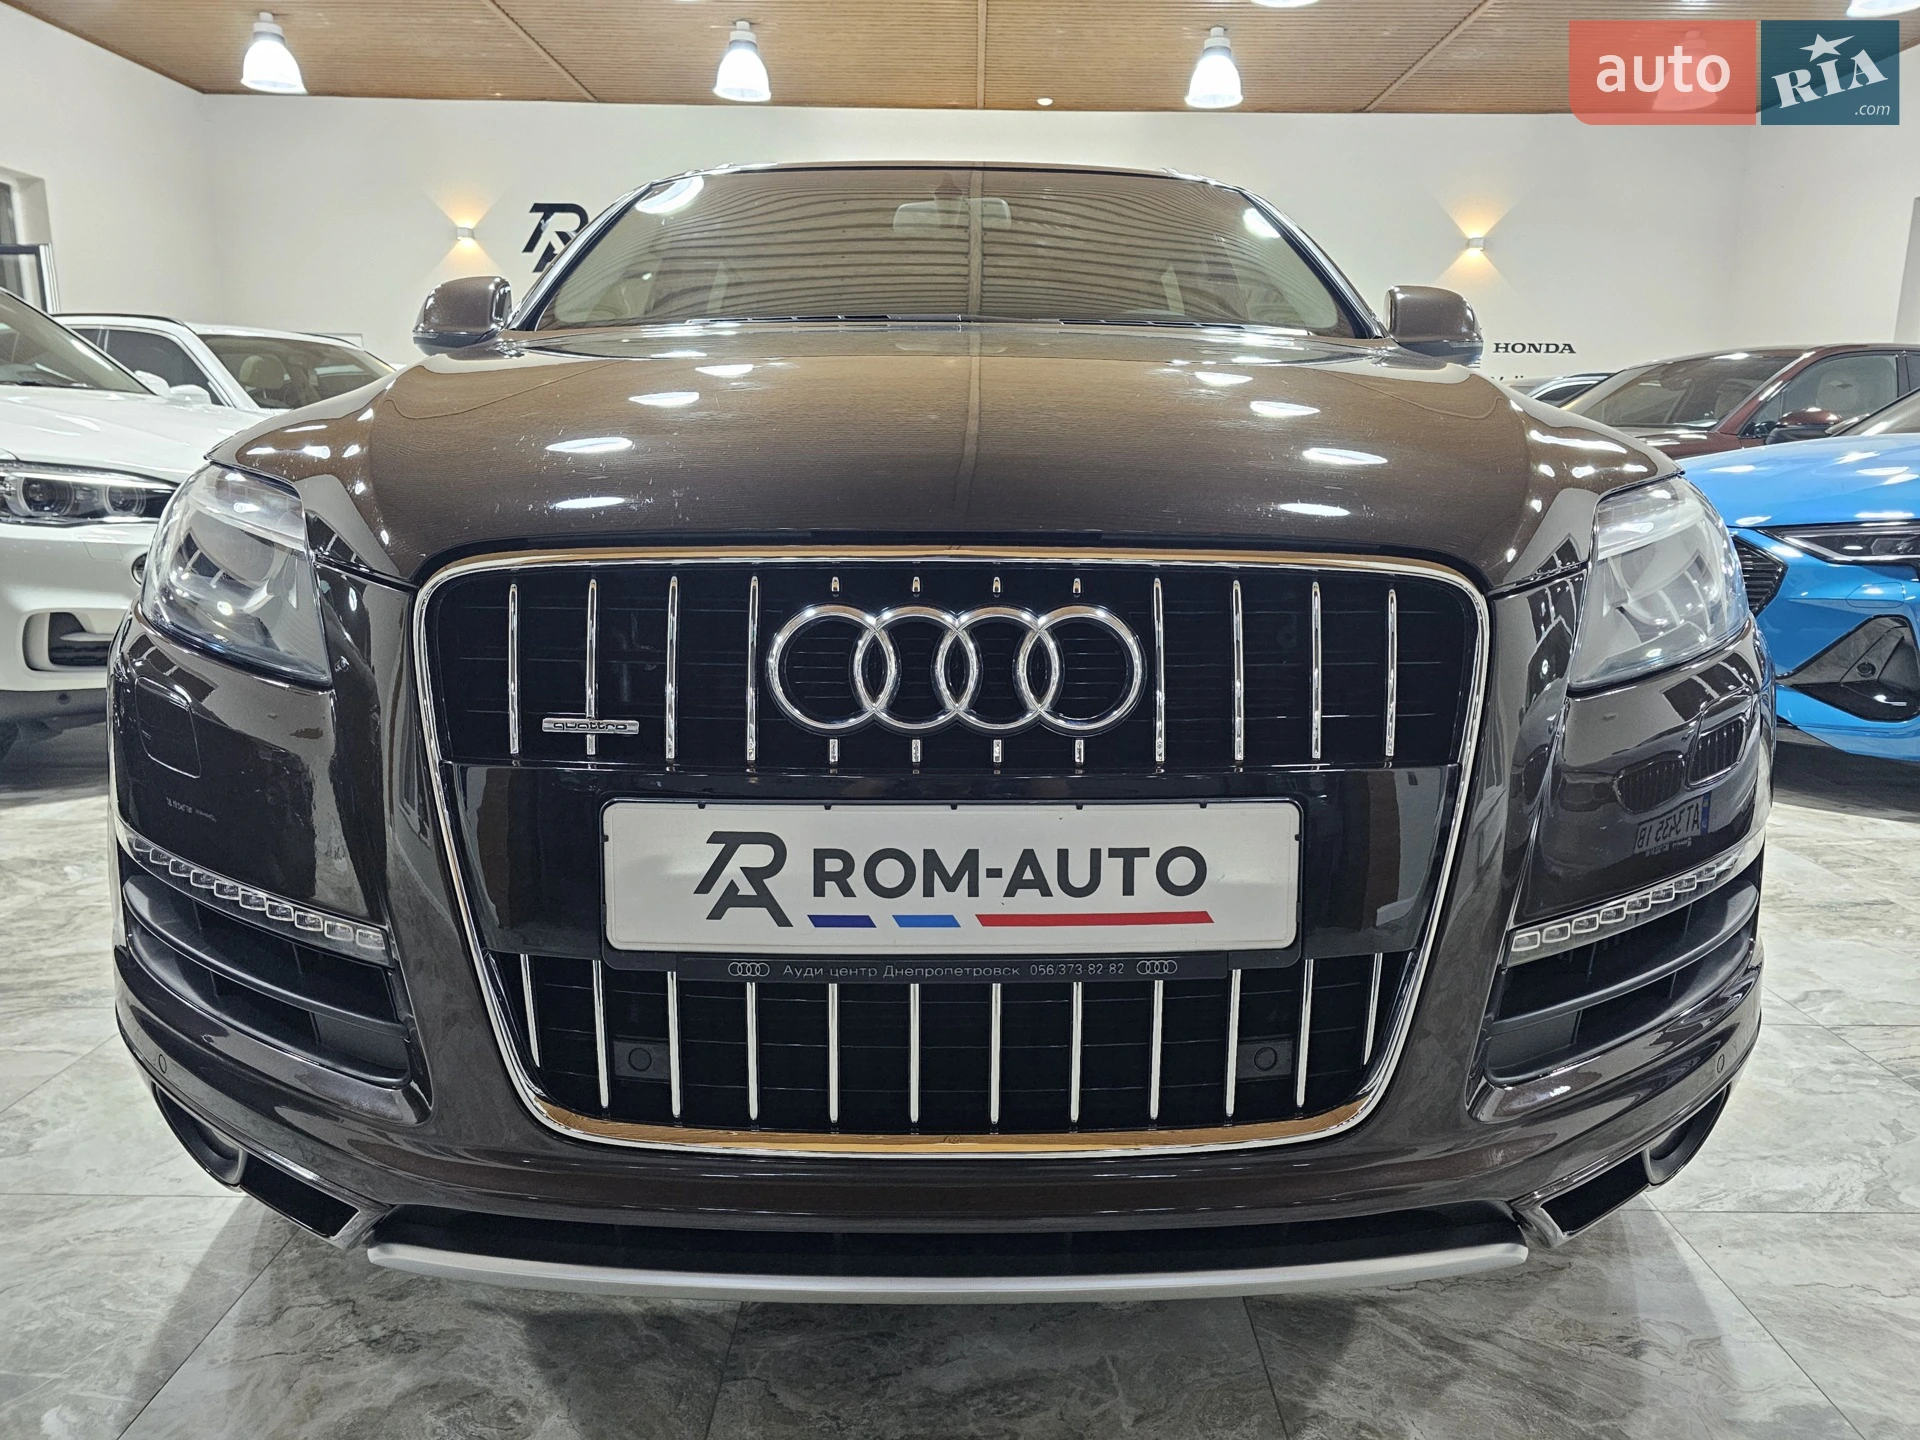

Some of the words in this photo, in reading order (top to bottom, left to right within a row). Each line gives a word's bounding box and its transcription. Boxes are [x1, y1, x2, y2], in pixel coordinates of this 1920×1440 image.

[1493, 342, 1577, 354] HONDA
[553, 722, 628, 731] quattro
[813, 846, 1207, 899] ROM-AUTO
[883, 965, 1020, 978] Днепропетровск
